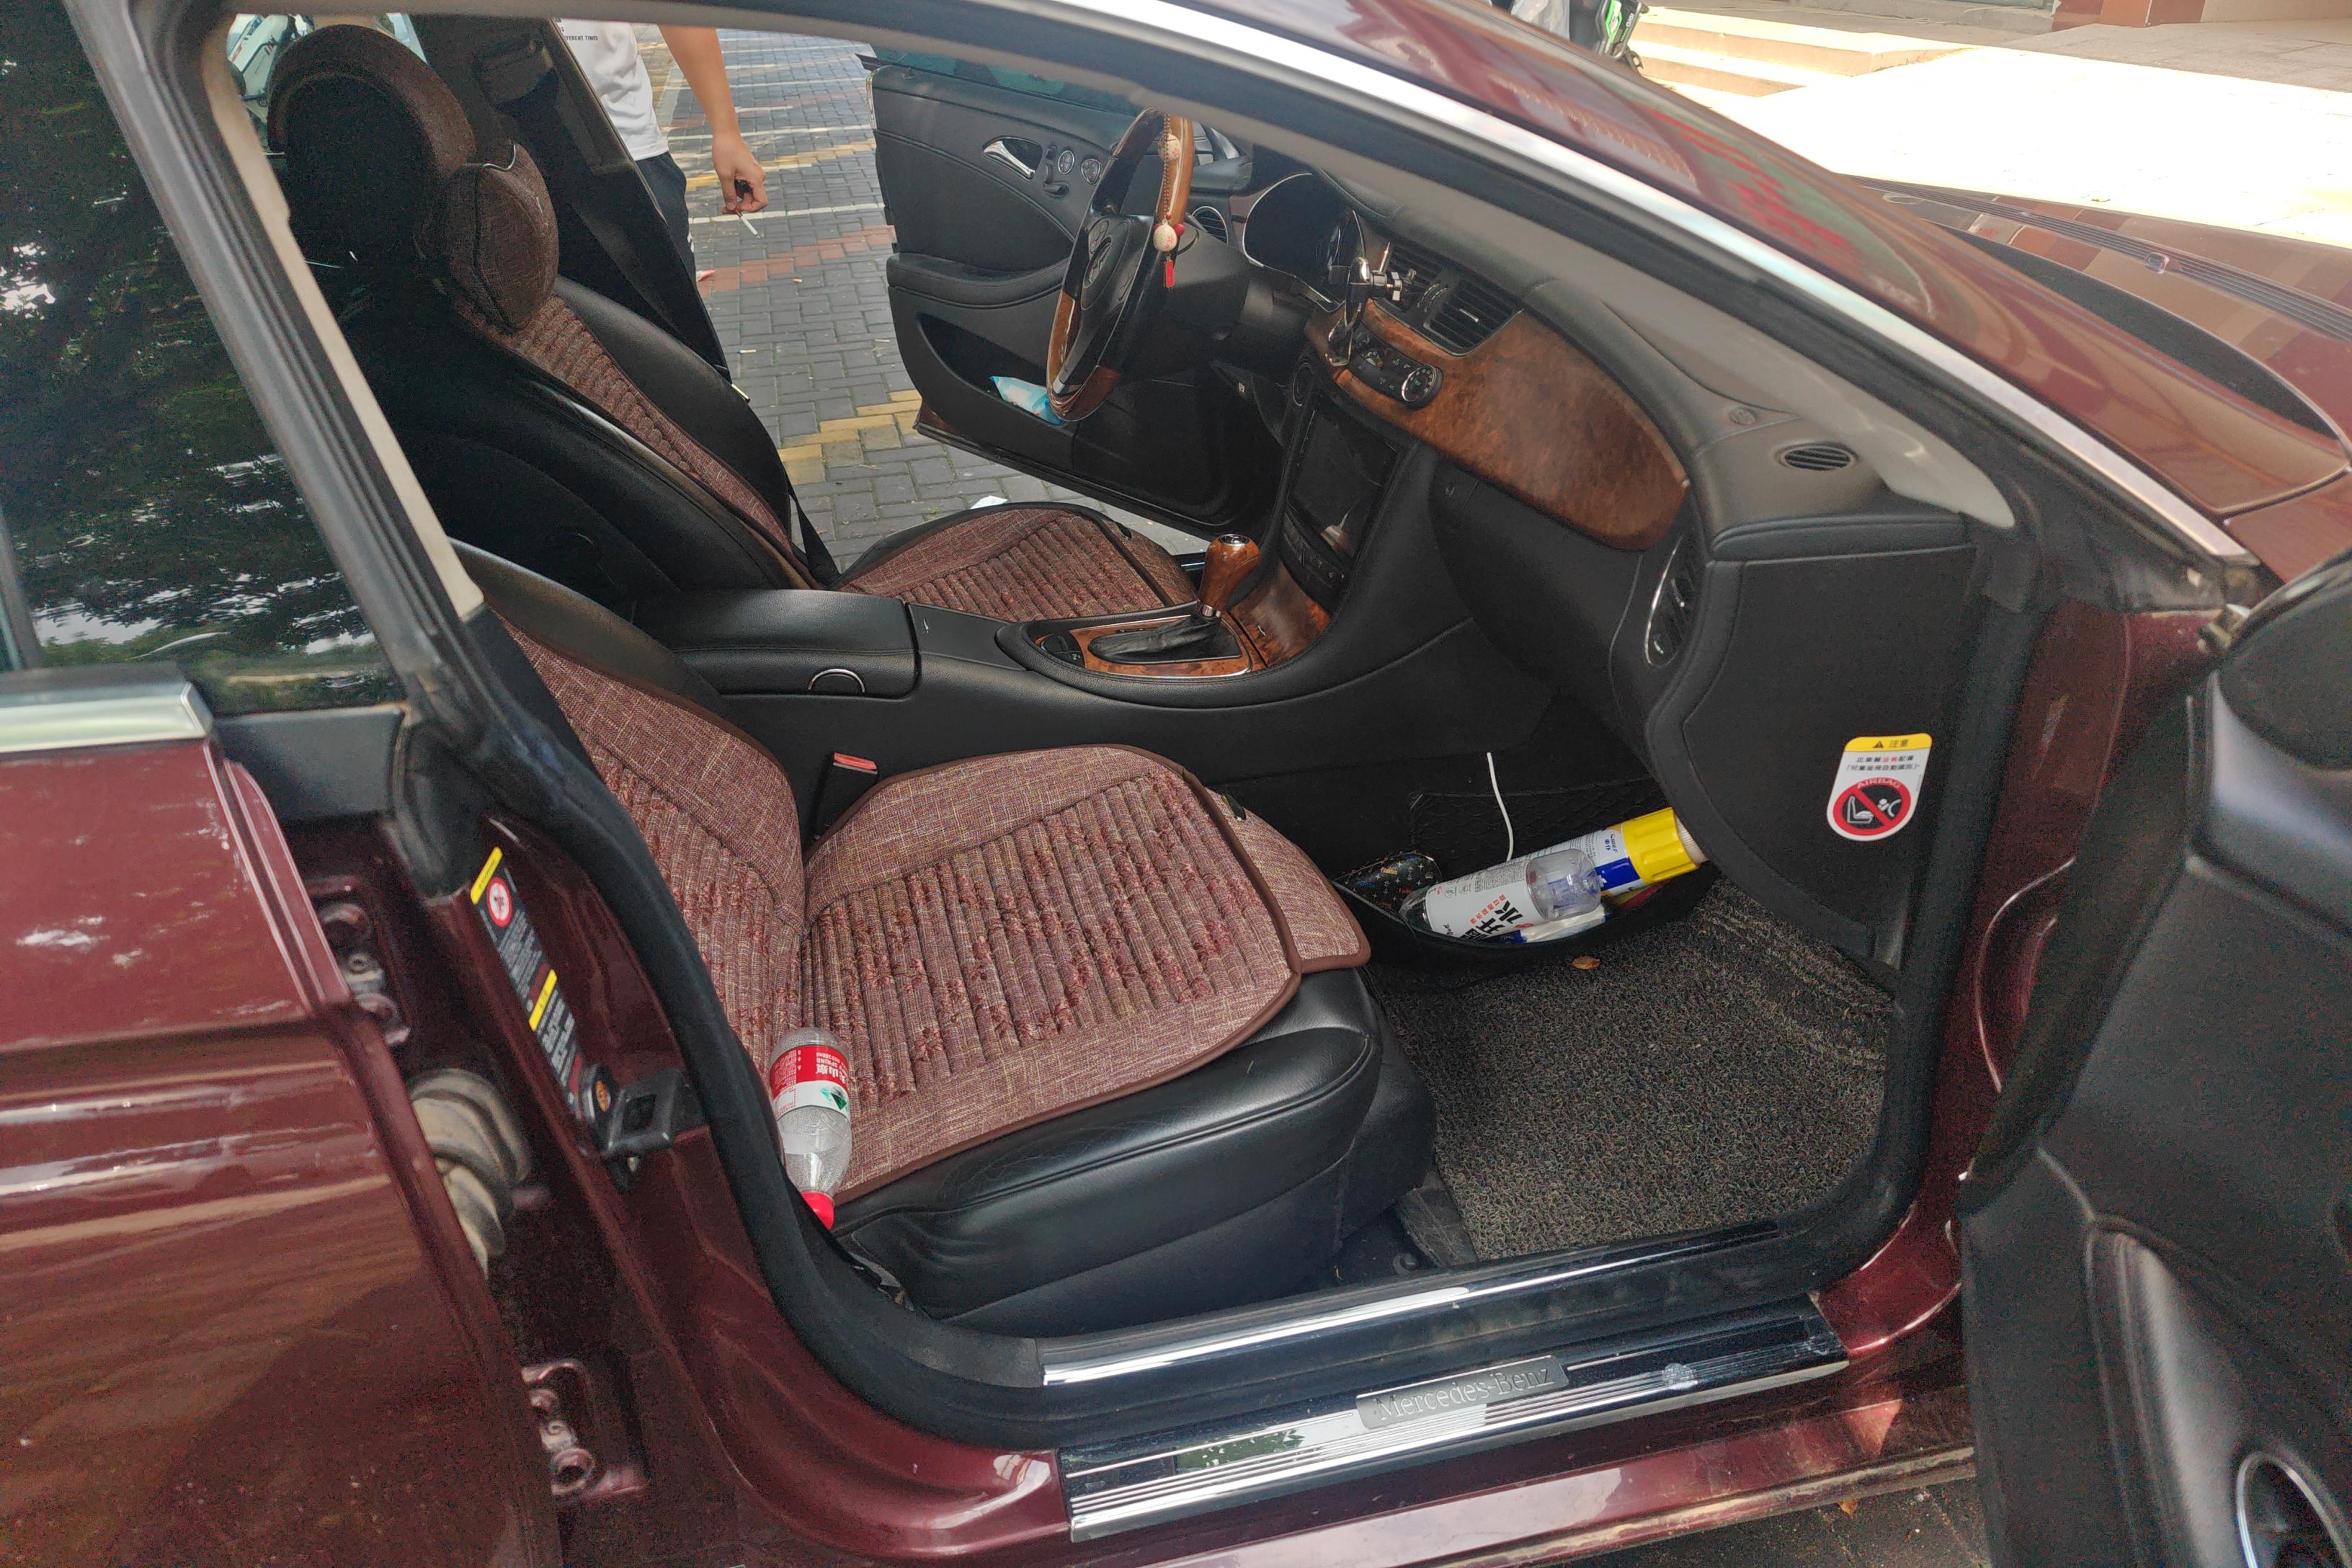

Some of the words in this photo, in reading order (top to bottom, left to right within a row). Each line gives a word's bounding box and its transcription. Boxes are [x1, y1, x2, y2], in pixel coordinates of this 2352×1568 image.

[1889, 739, 1909, 747] 注意
[1857, 778, 1901, 789] AIRBAG
[1373, 1366, 1554, 1421] Mercedes-Benz
